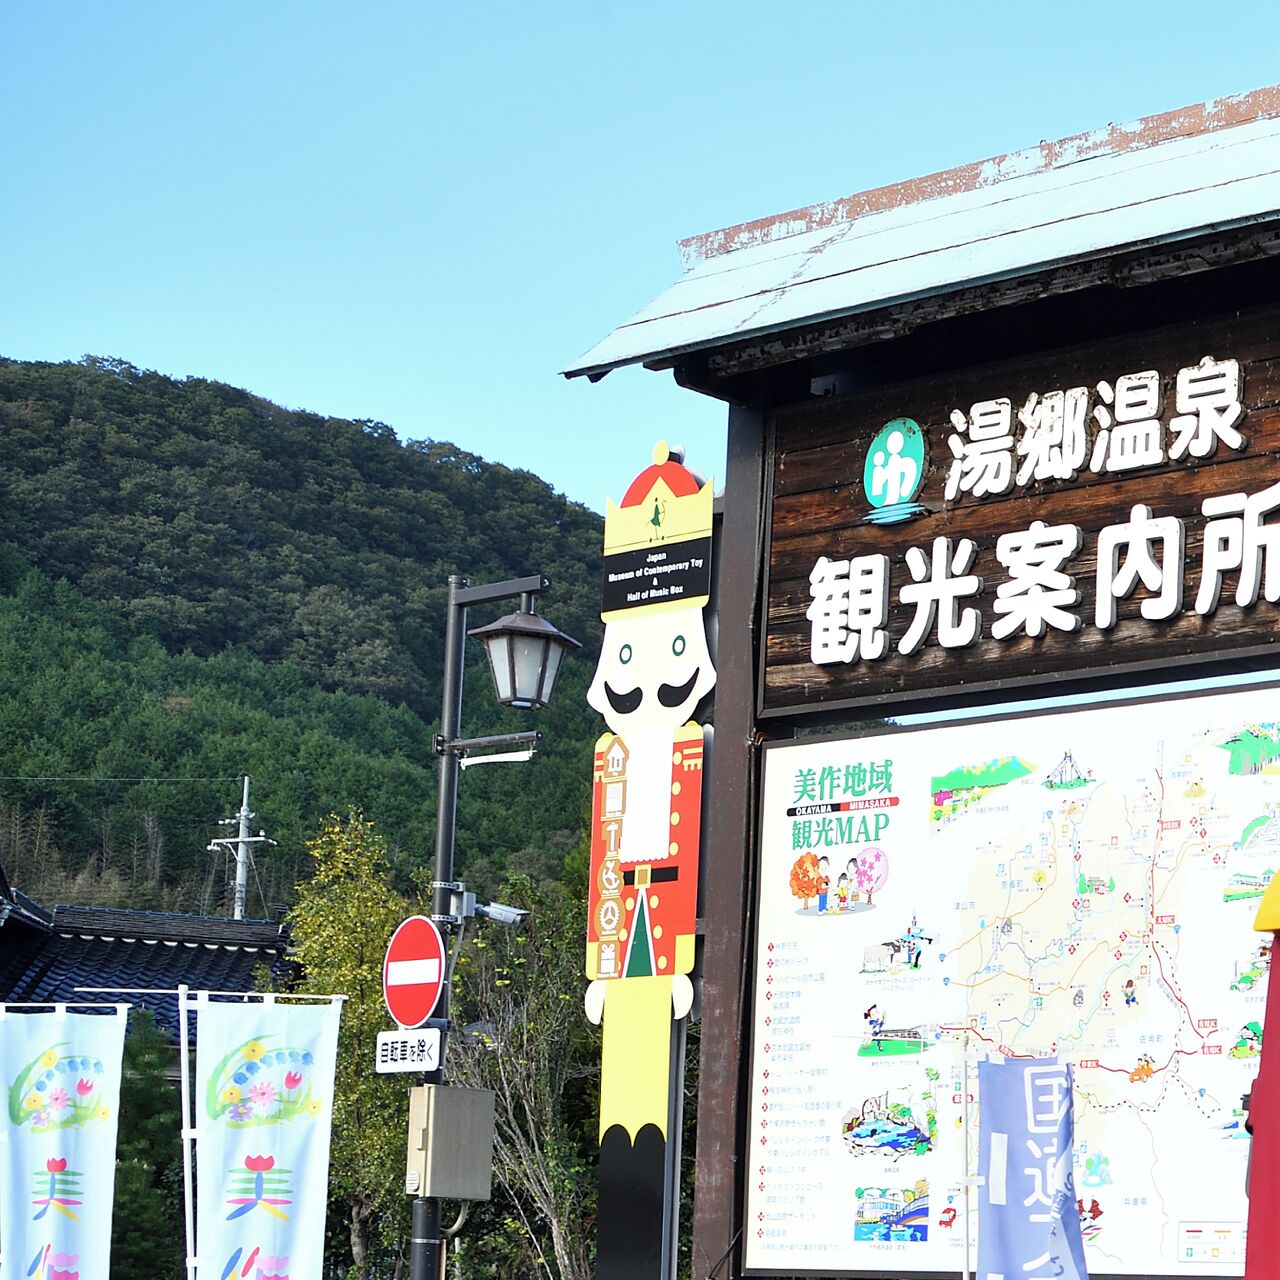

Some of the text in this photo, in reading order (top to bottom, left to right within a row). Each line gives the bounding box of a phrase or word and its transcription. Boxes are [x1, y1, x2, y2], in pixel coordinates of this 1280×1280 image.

[944, 356, 1247, 500] 湯郷温泉
[646, 552, 667, 563] Japan
[608, 558, 704, 582] Museum of Contemporary Toy
[627, 585, 684, 602] Hall of Music Box
[793, 759, 894, 804] 美作地域
[795, 798, 891, 816] OKAYAMA MIMASAKA
[791, 813, 890, 850] 観光MAP
[381, 1038, 433, 1063] 自転車を除く
